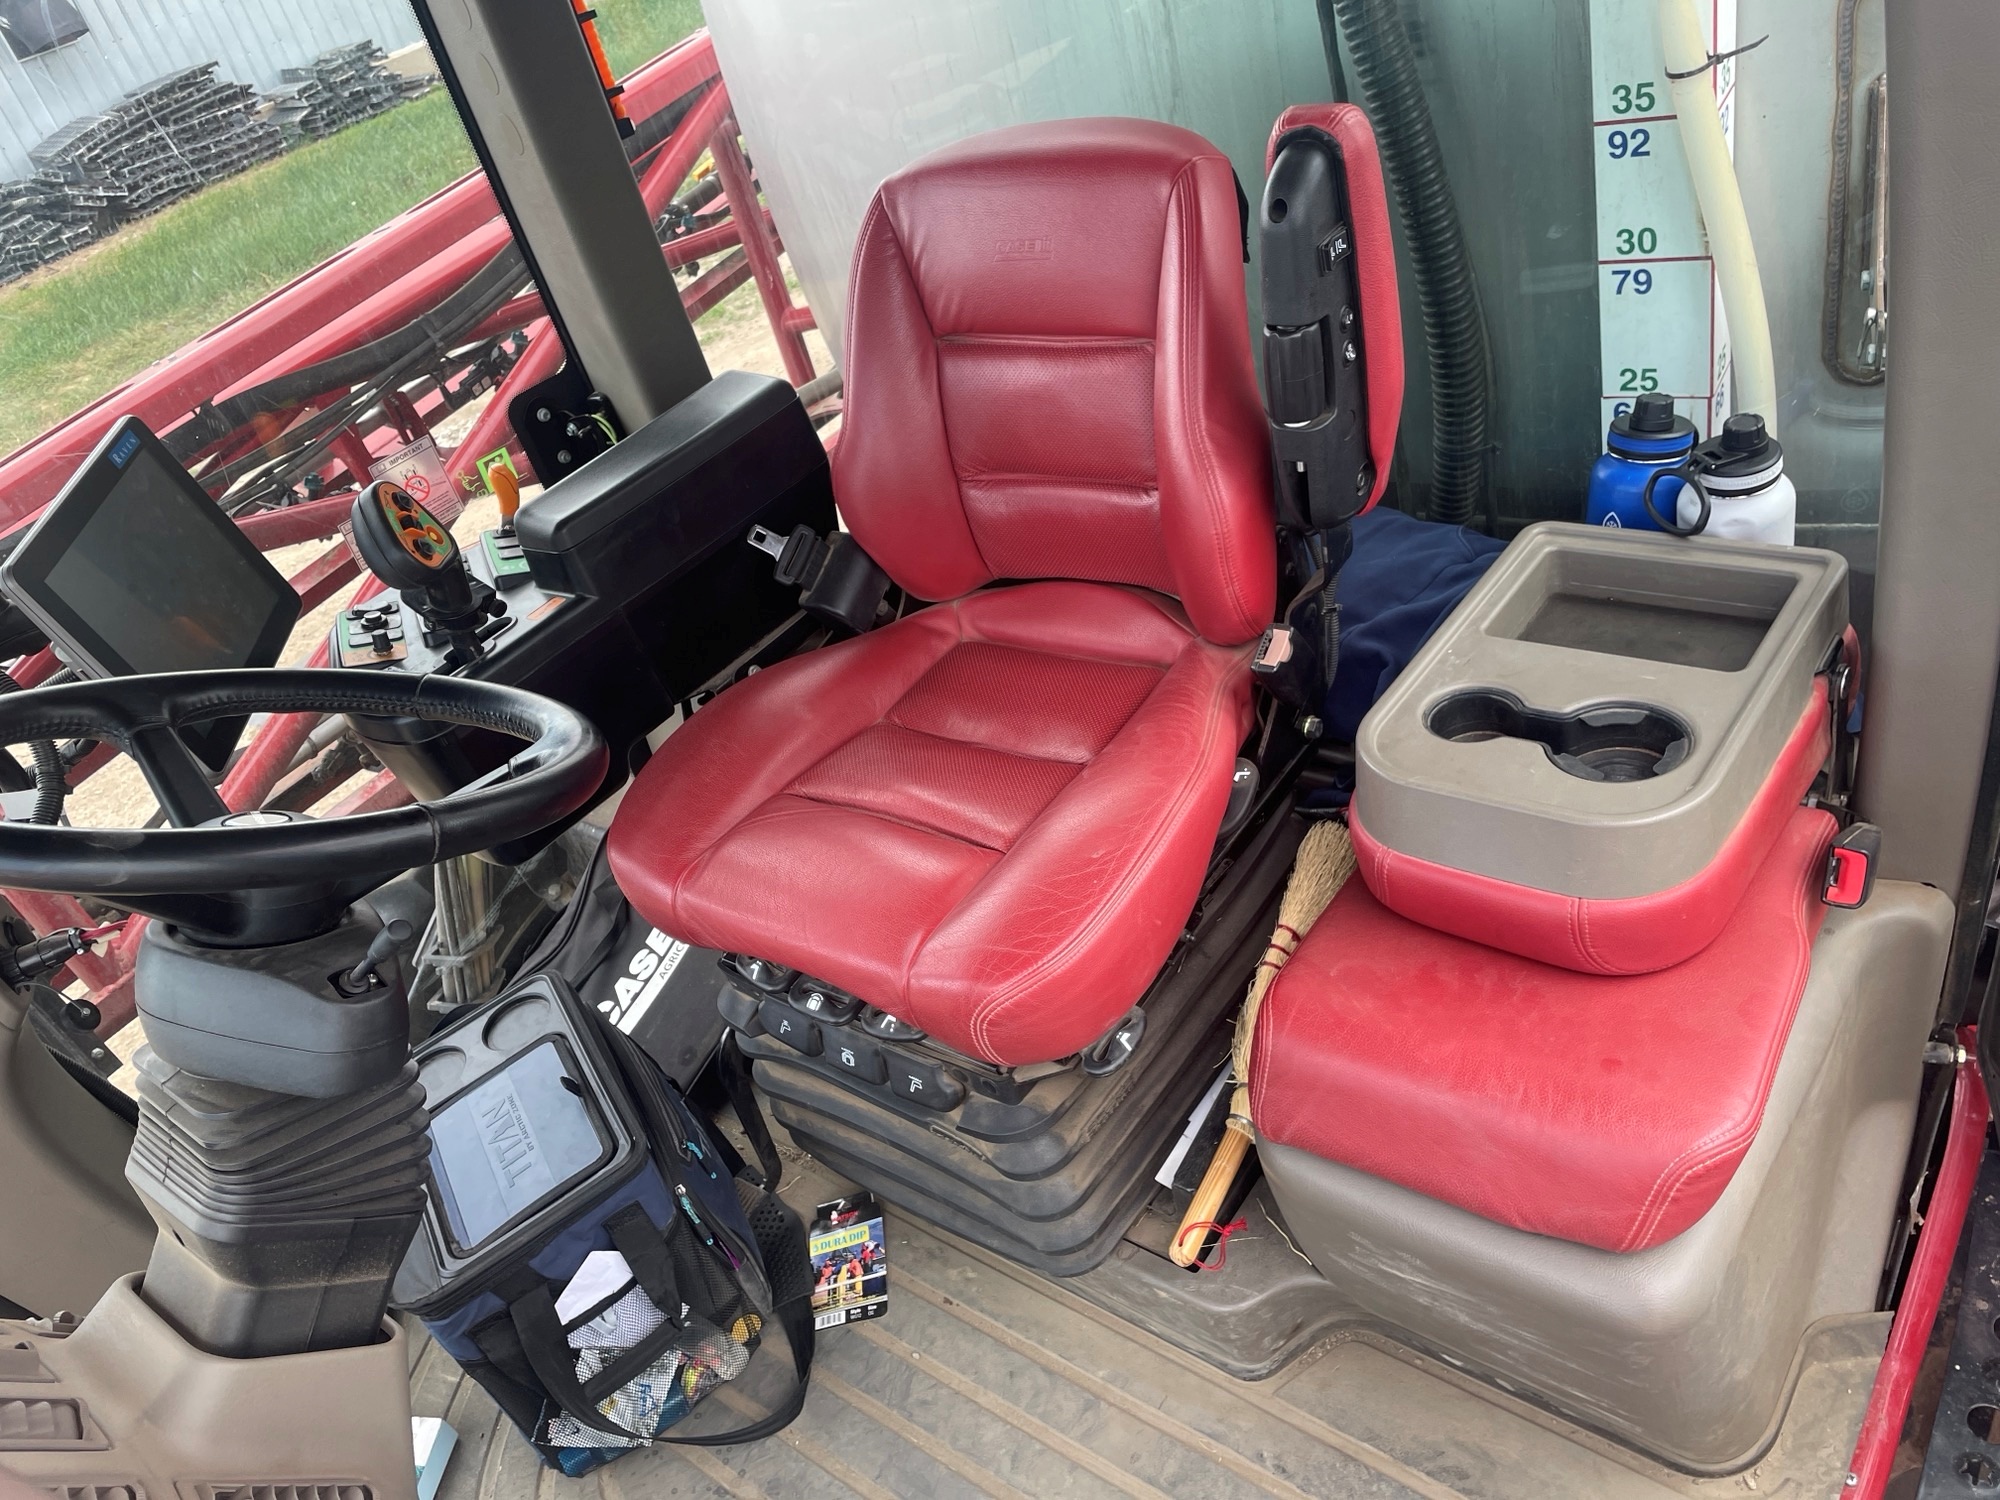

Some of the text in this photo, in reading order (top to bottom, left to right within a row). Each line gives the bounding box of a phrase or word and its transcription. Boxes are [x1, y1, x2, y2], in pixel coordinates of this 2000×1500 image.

[1612, 82, 1655, 114] 35
[1608, 128, 1650, 159] 92
[1616, 227, 1657, 255] 30
[1611, 268, 1652, 295] 79
[1619, 368, 1659, 392] 25
[388, 443, 424, 466] IMPORTANT
[507, 1093, 535, 1152] BY ARCTIC ZONE
[482, 1098, 532, 1189] TITAN
[820, 1230, 866, 1250] DURA DIP
